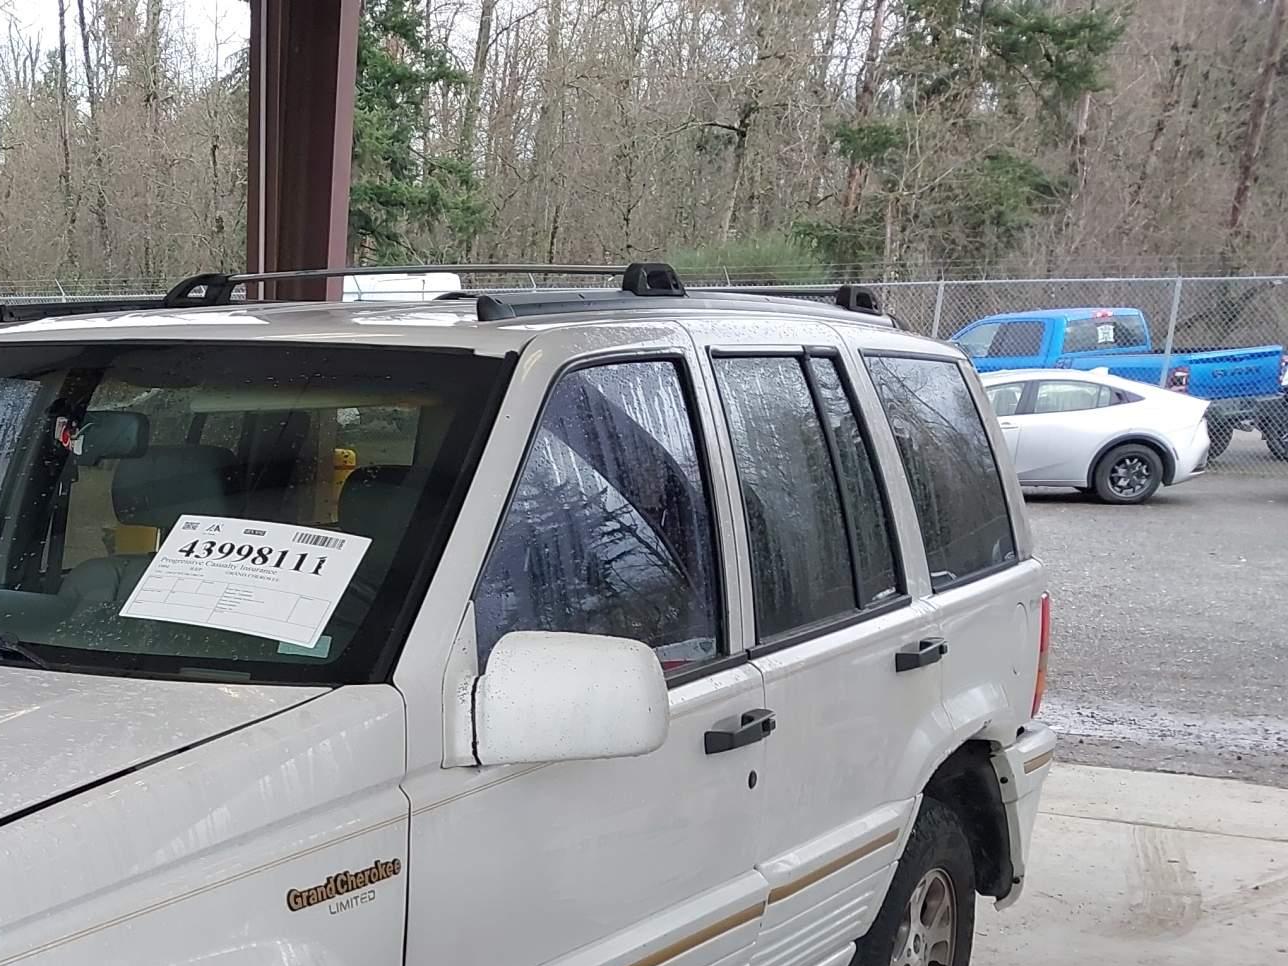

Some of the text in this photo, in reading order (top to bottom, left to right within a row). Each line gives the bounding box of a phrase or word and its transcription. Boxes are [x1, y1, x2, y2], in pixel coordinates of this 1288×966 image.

[178, 539, 328, 576] 43998111
[205, 561, 238, 571] Casualty
[240, 564, 278, 576] Insurance
[328, 889, 376, 915] LIMITED
